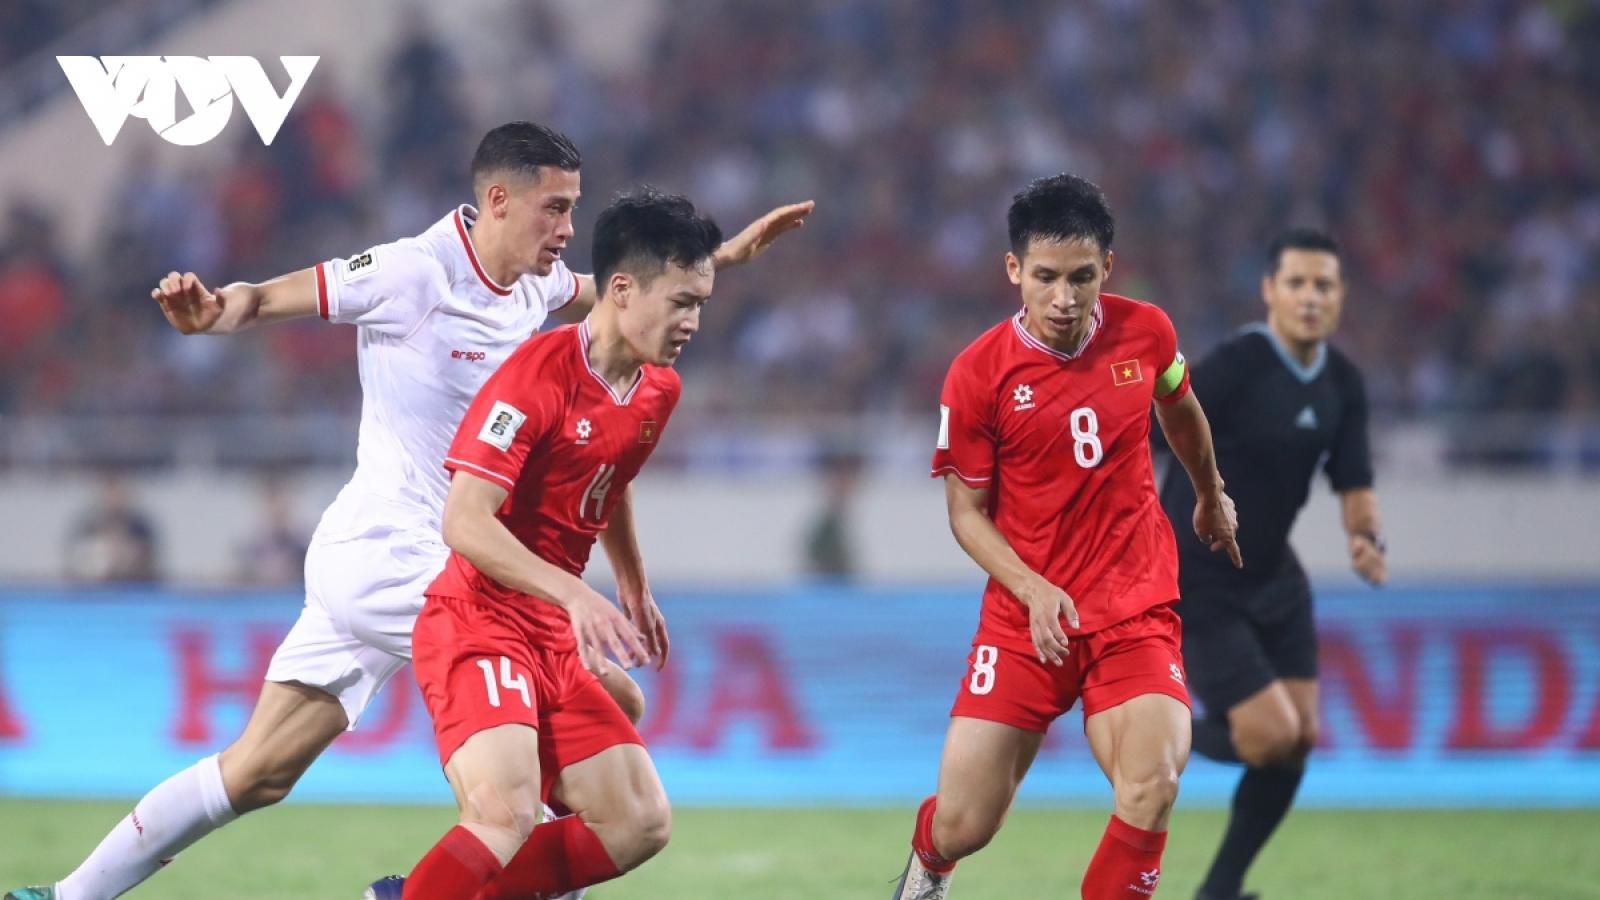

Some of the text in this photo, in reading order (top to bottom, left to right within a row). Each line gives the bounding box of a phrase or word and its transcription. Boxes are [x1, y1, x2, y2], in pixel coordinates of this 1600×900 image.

[451, 350, 485, 362] erspo
[1070, 407, 1103, 468] 8
[579, 464, 616, 519] 14
[476, 655, 531, 708] 14
[969, 644, 998, 695] 8
